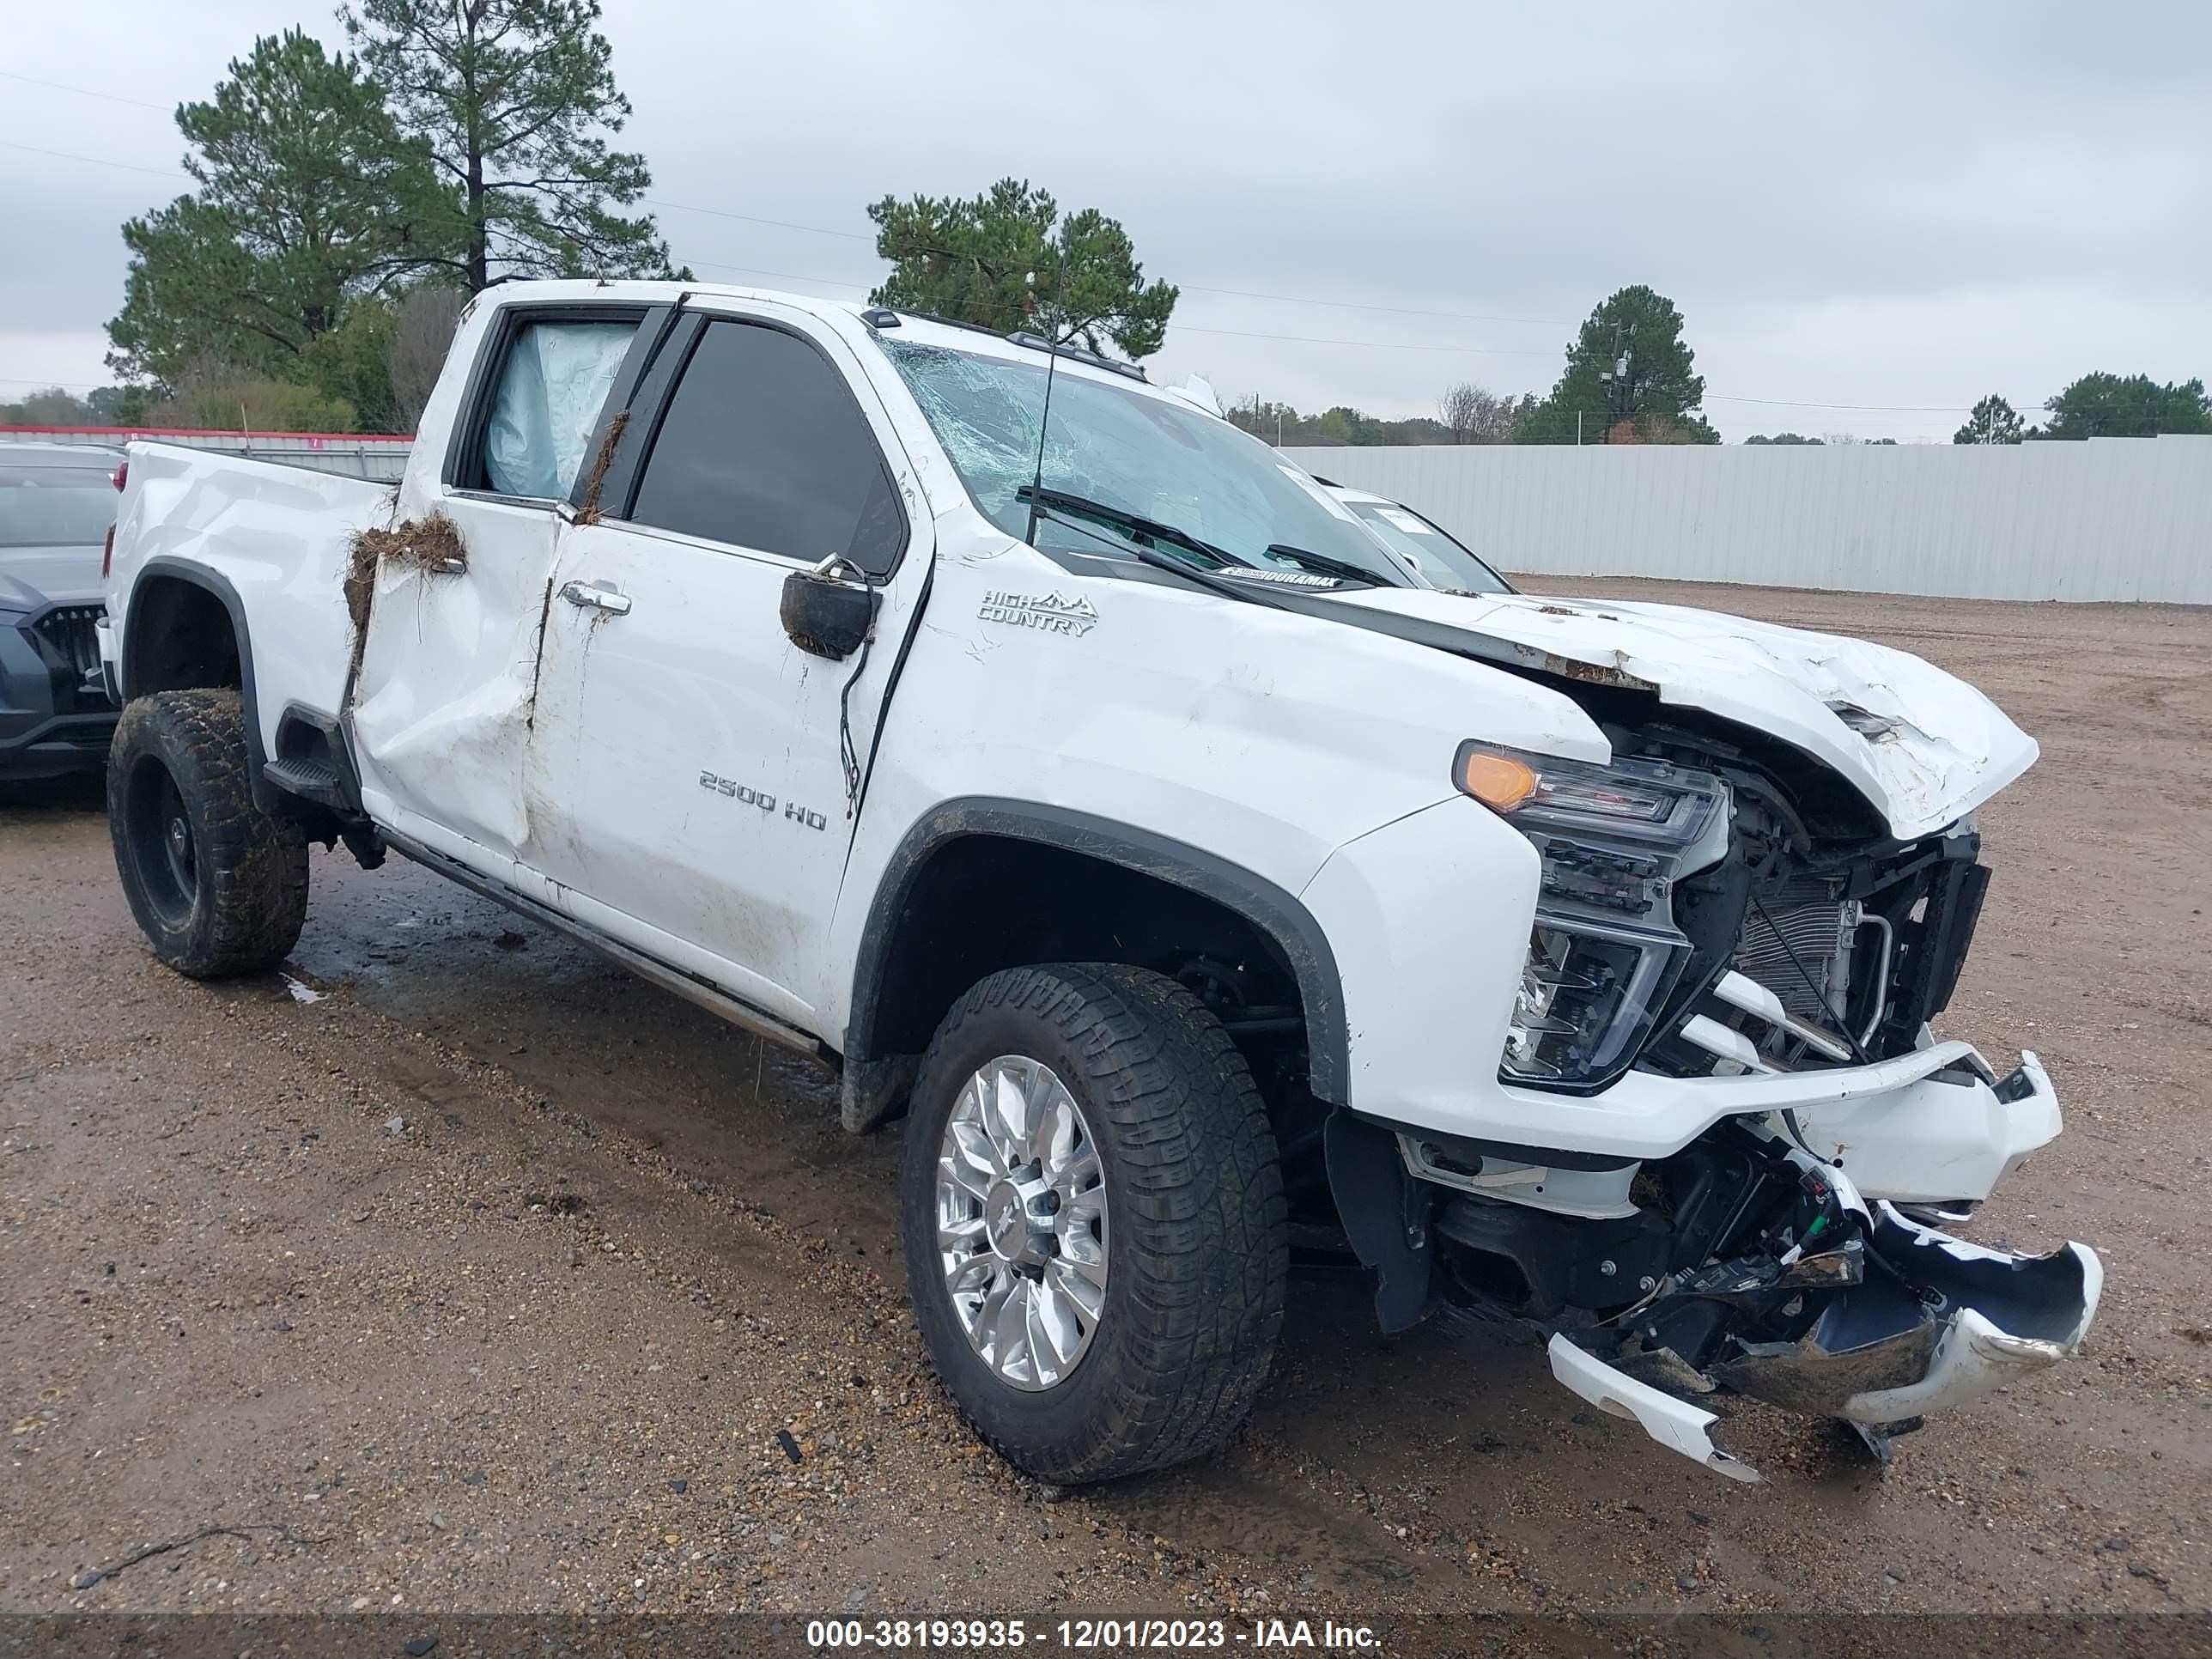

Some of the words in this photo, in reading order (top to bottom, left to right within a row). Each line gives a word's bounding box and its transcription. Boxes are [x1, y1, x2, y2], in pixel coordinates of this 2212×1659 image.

[1264, 571, 1340, 587] DURAMAX
[982, 590, 1037, 610] HIGH
[977, 607, 1095, 637] COUNTRY
[700, 769, 776, 811] 2500
[785, 799, 827, 831] HD
